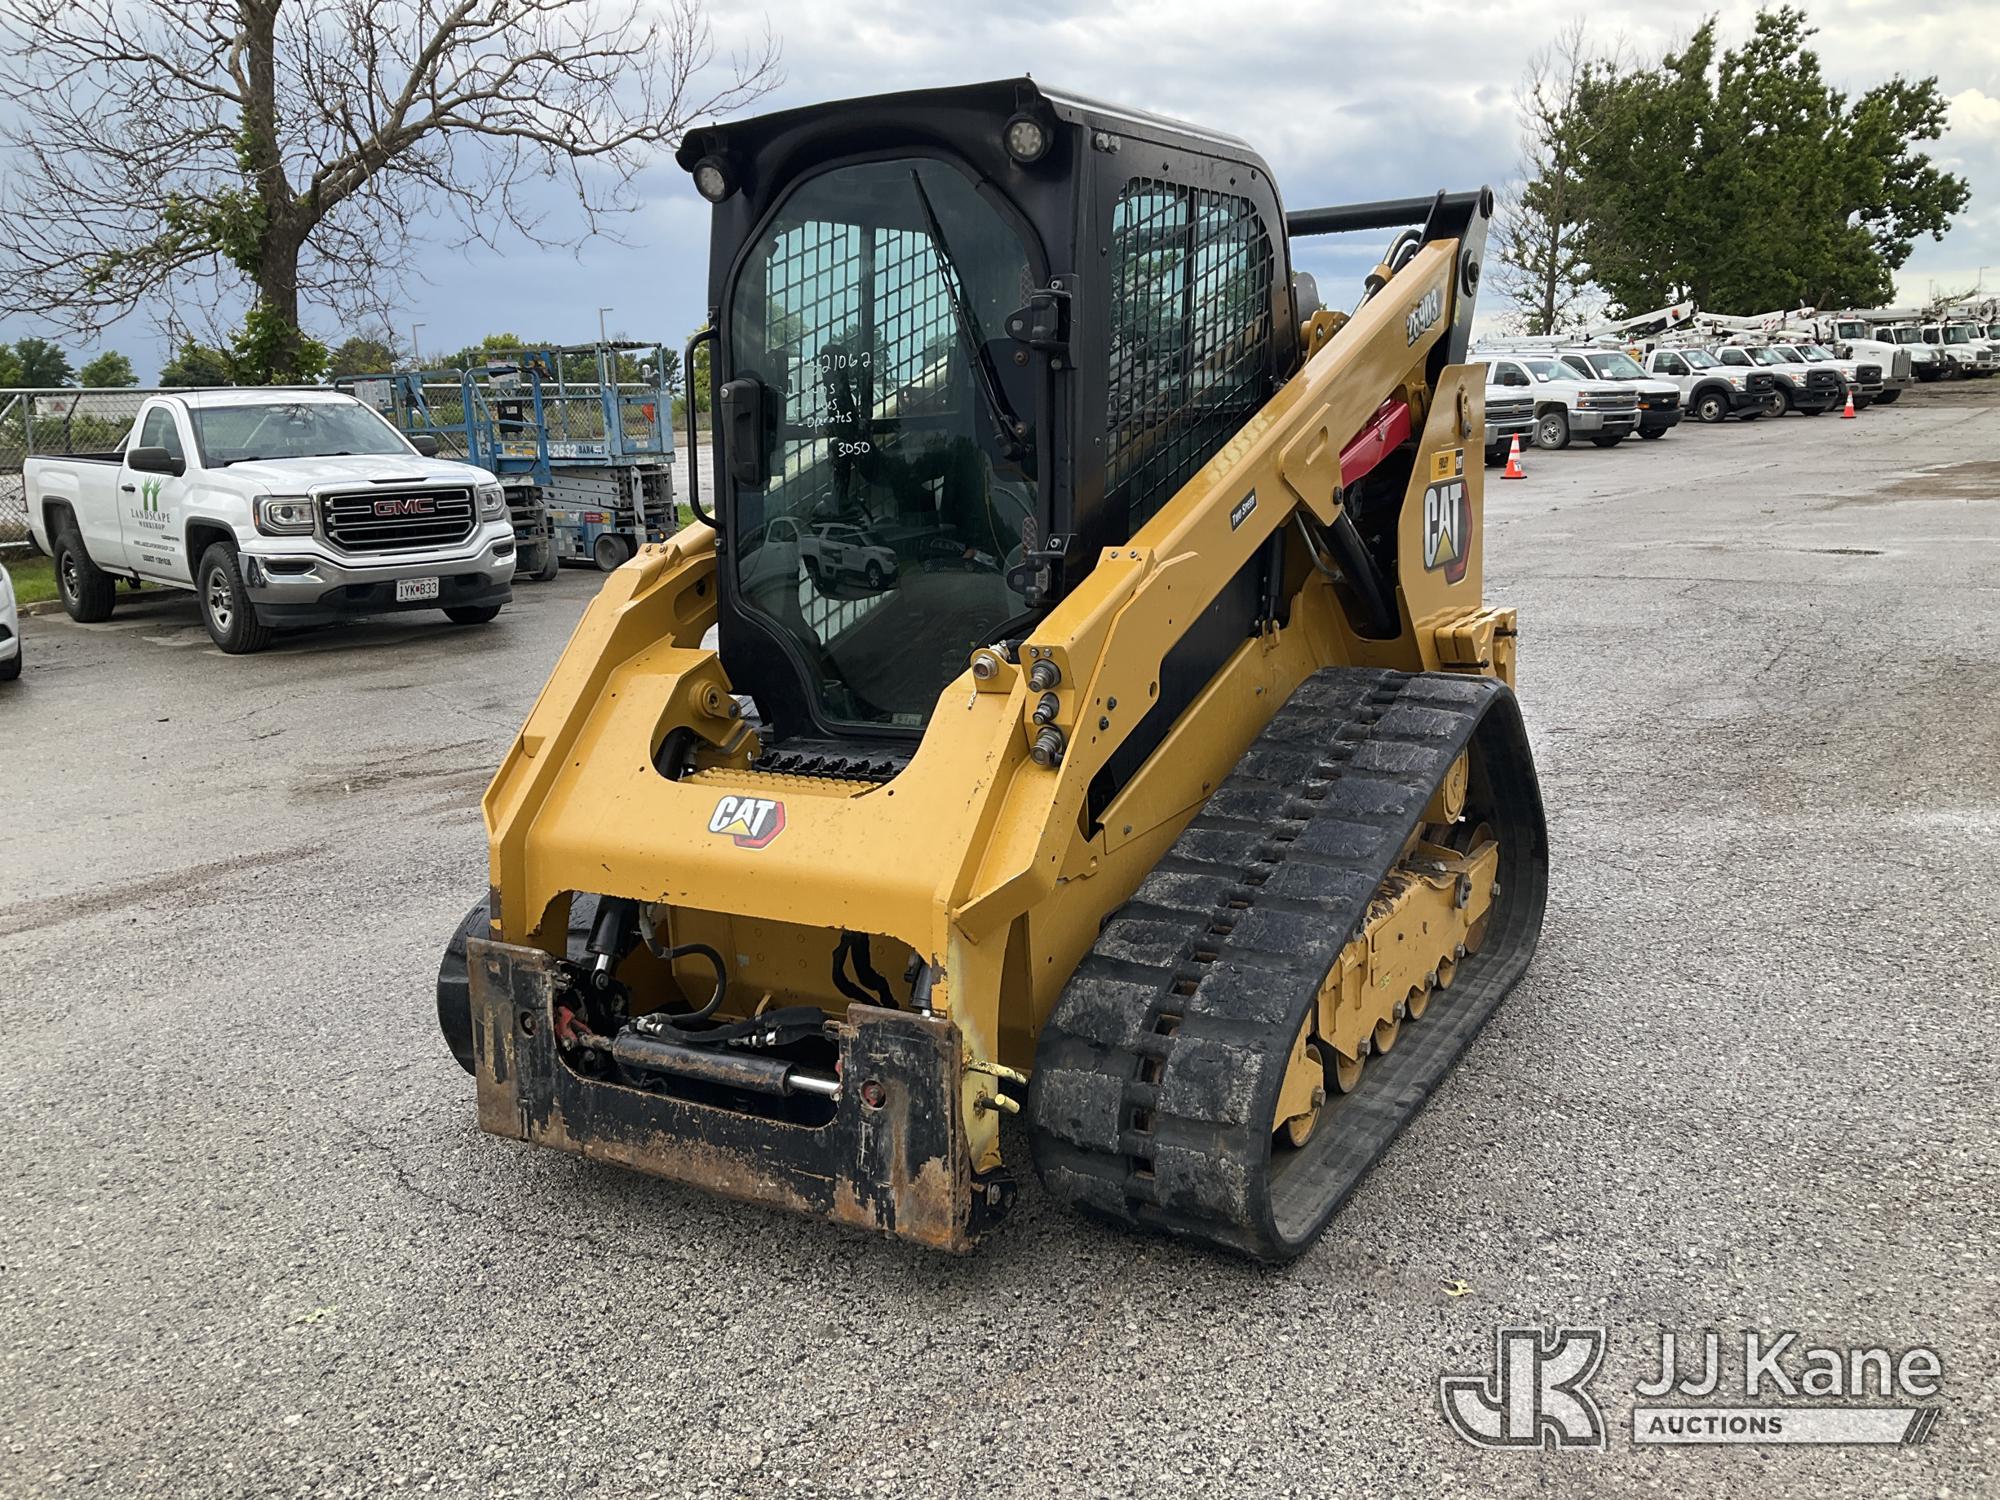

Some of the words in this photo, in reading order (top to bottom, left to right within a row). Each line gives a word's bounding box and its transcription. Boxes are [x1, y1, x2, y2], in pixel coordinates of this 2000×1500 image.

[838, 441, 871, 457] 3050
[131, 508, 171, 523] LANDSCAPE
[374, 498, 435, 516] GMC
[1424, 482, 1462, 568] CAT
[709, 796, 777, 837] CAT
